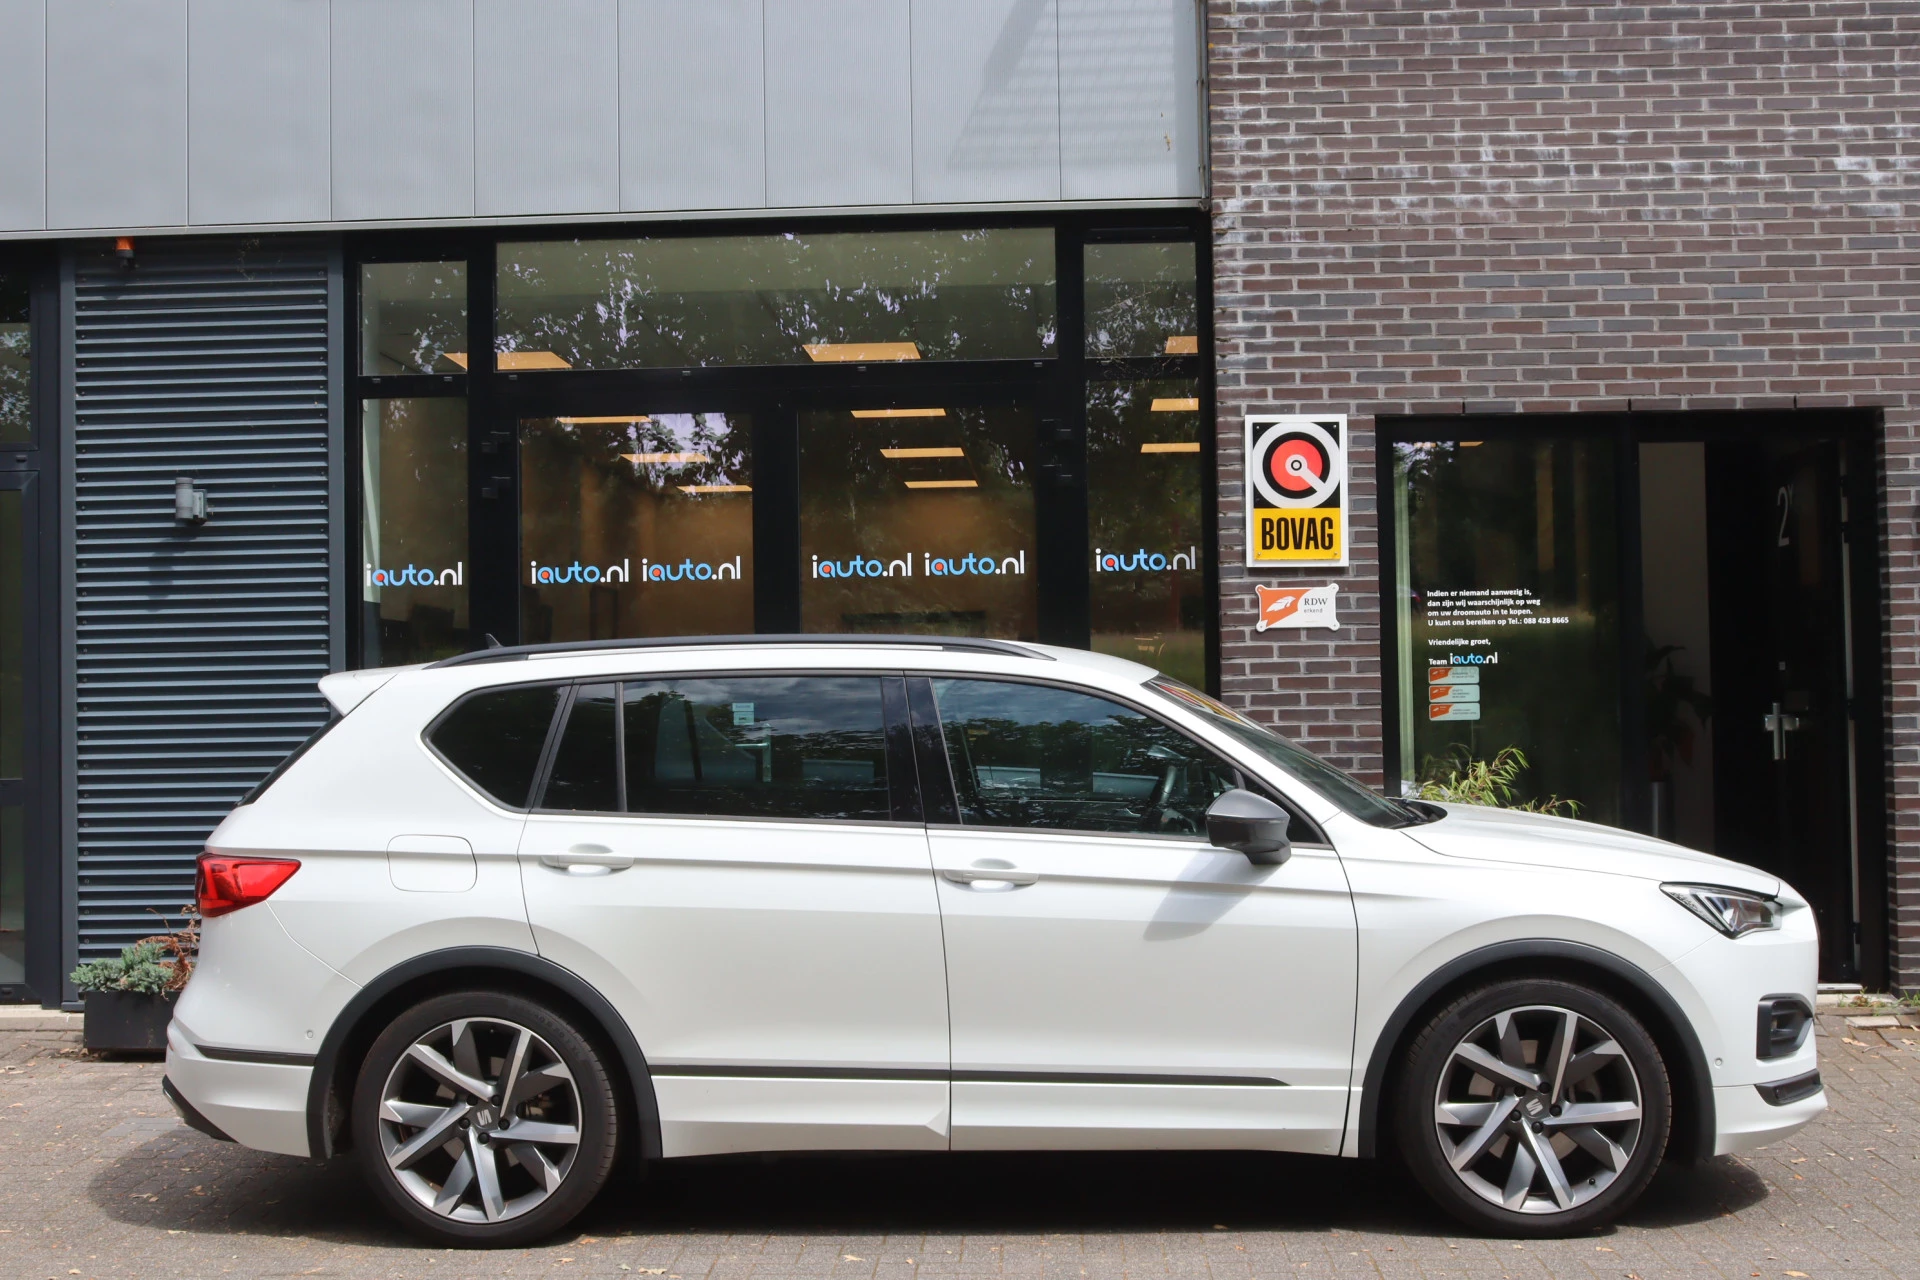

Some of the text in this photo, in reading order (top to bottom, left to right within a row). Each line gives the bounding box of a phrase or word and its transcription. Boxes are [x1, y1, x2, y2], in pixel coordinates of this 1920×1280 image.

[1261, 516, 1334, 550] BOVAG
[812, 550, 1025, 578] iauto.nl iauto.nl
[1095, 546, 1196, 572] iauto.nl
[365, 561, 463, 587] iauto.nl
[530, 555, 741, 585] iauto.nl iauto.nl
[1459, 589, 1490, 597] niemand
[1490, 588, 1523, 597] aanwezig
[1523, 588, 1532, 596] is,
[1304, 598, 1328, 606] RDW
[1427, 599, 1441, 607] dan
[1441, 599, 1454, 608] zijn
[1455, 599, 1466, 608] wij
[1467, 598, 1515, 607] waarschijnlijk
[1526, 598, 1541, 606] weg
[1452, 608, 1492, 616] droomauto
[1492, 608, 1500, 616] in
[1509, 608, 1533, 616] kopen.
[1427, 619, 1434, 627] U
[1465, 618, 1496, 626] bereiken
[1428, 638, 1492, 647] Vriendelijke groet,
[1449, 651, 1498, 665] iauto.nl
